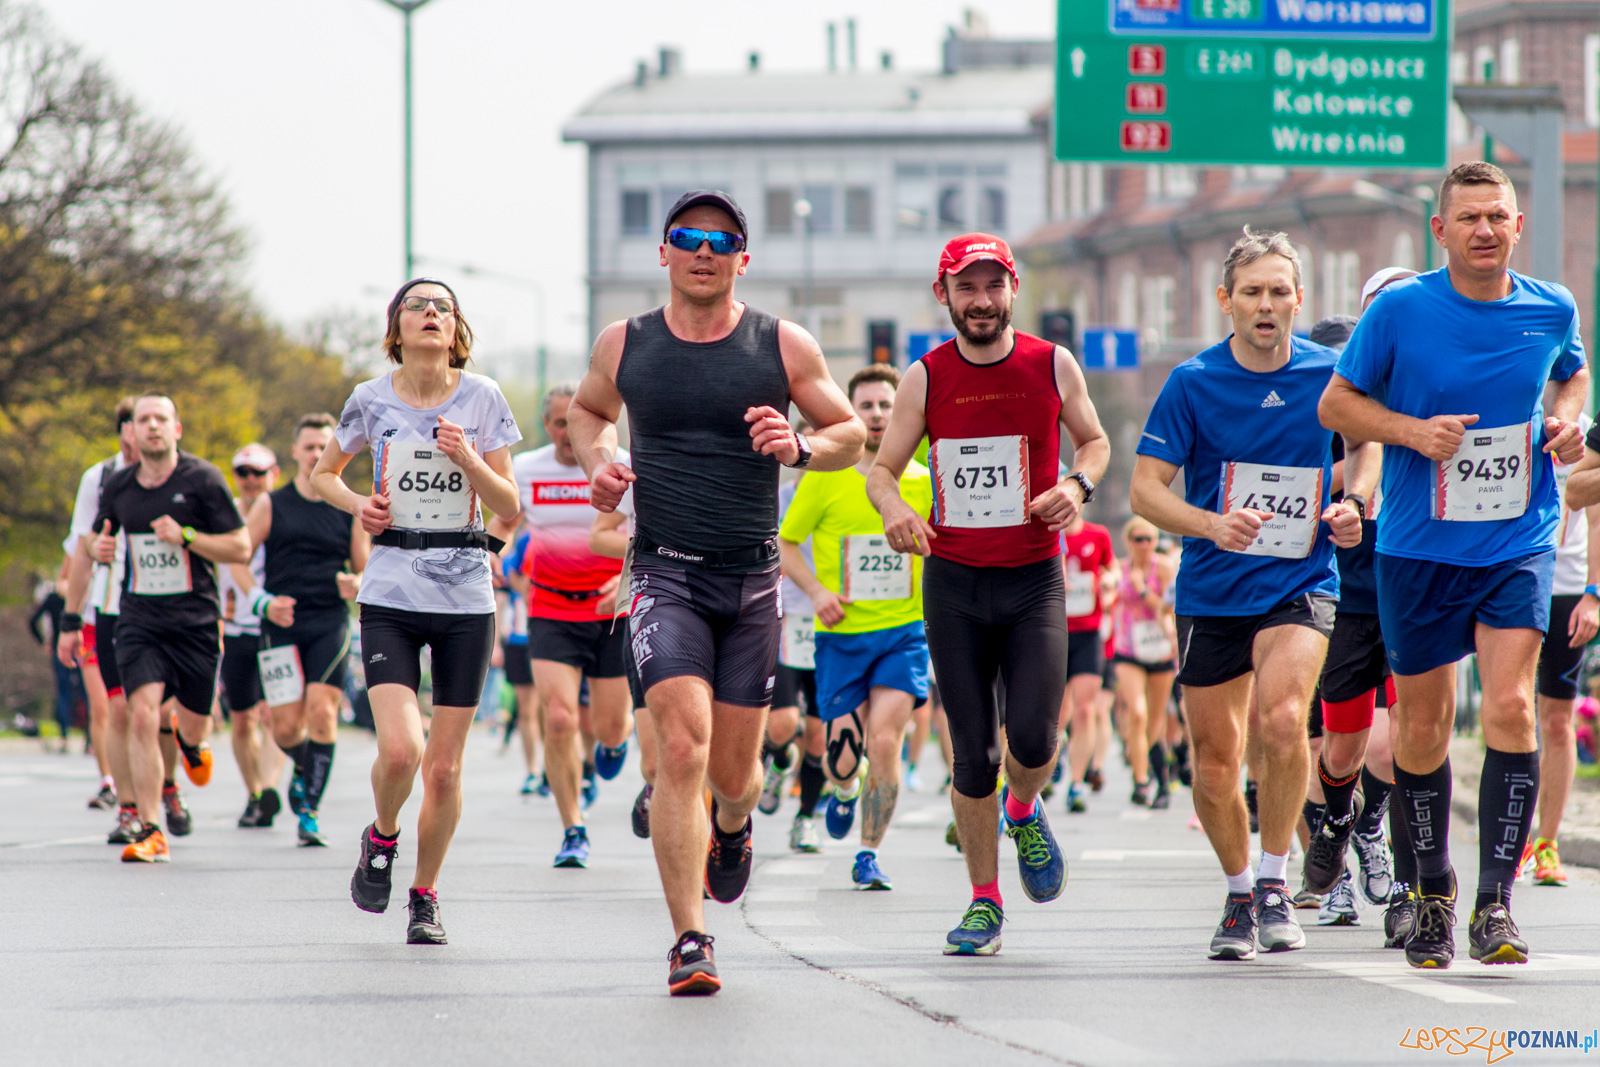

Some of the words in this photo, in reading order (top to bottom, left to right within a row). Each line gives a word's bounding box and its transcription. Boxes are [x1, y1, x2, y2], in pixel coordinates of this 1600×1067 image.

[1277, 0, 1426, 24] Warszawa
[1199, 49, 1210, 74] E
[1274, 47, 1426, 85] Bydgoszcz
[1273, 86, 1414, 118] Katowice
[955, 393, 1027, 404] BRUBECK
[1261, 400, 1286, 408] adidas
[953, 465, 1008, 489] 6731
[1457, 455, 1520, 482] 9439
[398, 471, 463, 493] 6548
[1478, 485, 1504, 493] PAWEŁ
[969, 493, 992, 501] Marek
[1242, 492, 1308, 520] 4342
[1261, 521, 1287, 530] Robert
[139, 552, 179, 568] 6036
[859, 555, 903, 571] 2252
